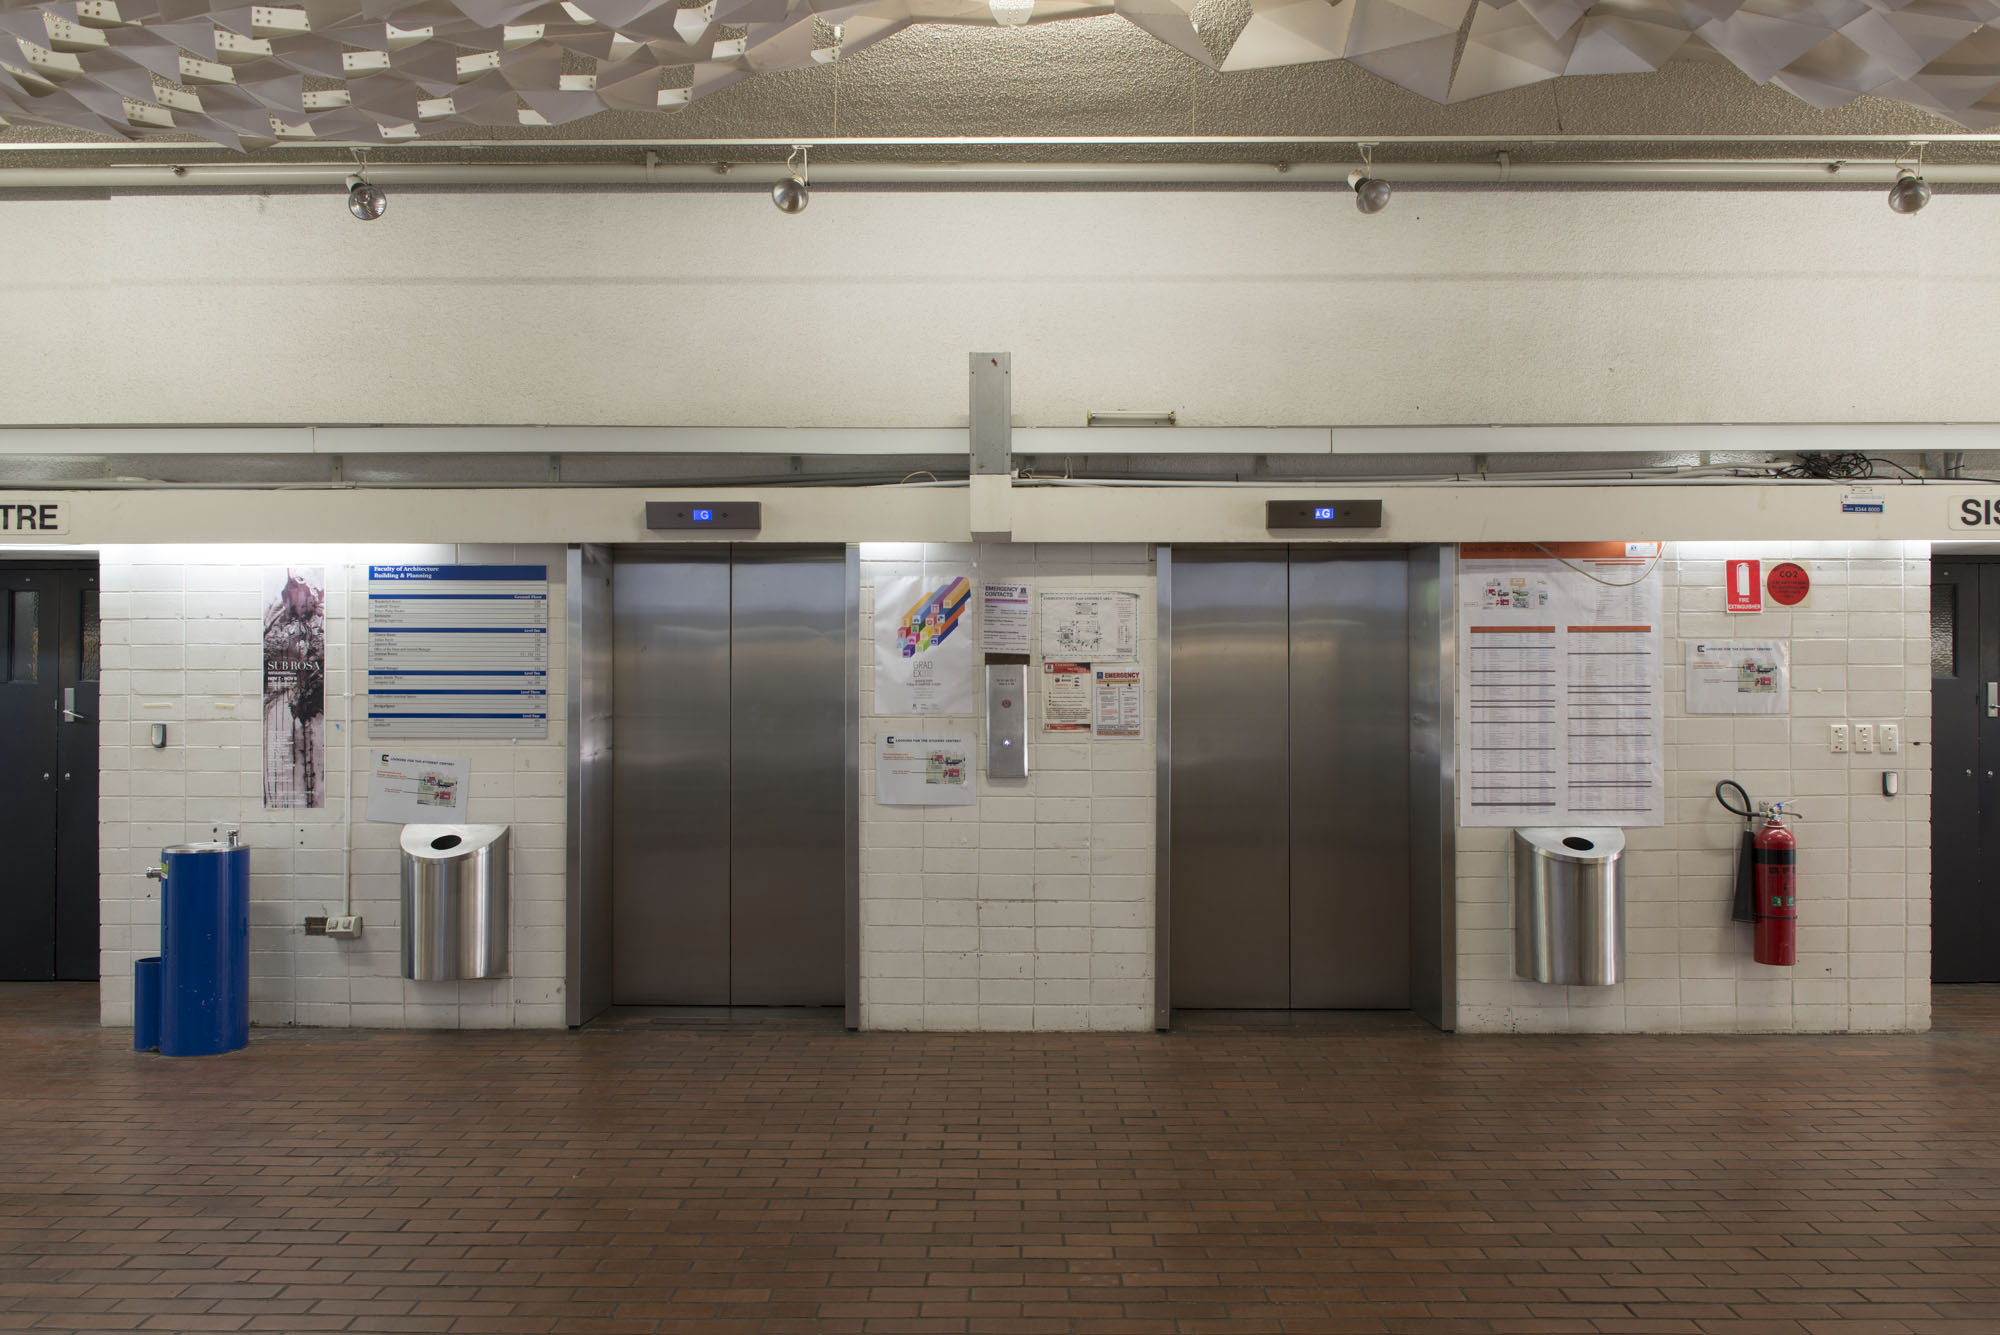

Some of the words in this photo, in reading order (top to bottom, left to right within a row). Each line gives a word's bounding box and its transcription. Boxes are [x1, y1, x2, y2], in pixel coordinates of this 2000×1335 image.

[0, 504, 58, 530] TRE
[700, 510, 709, 520] G
[1322, 508, 1330, 518] G
[268, 661, 289, 670] SUB
[290, 661, 320, 670] ROSA
[913, 660, 933, 670] GRAD
